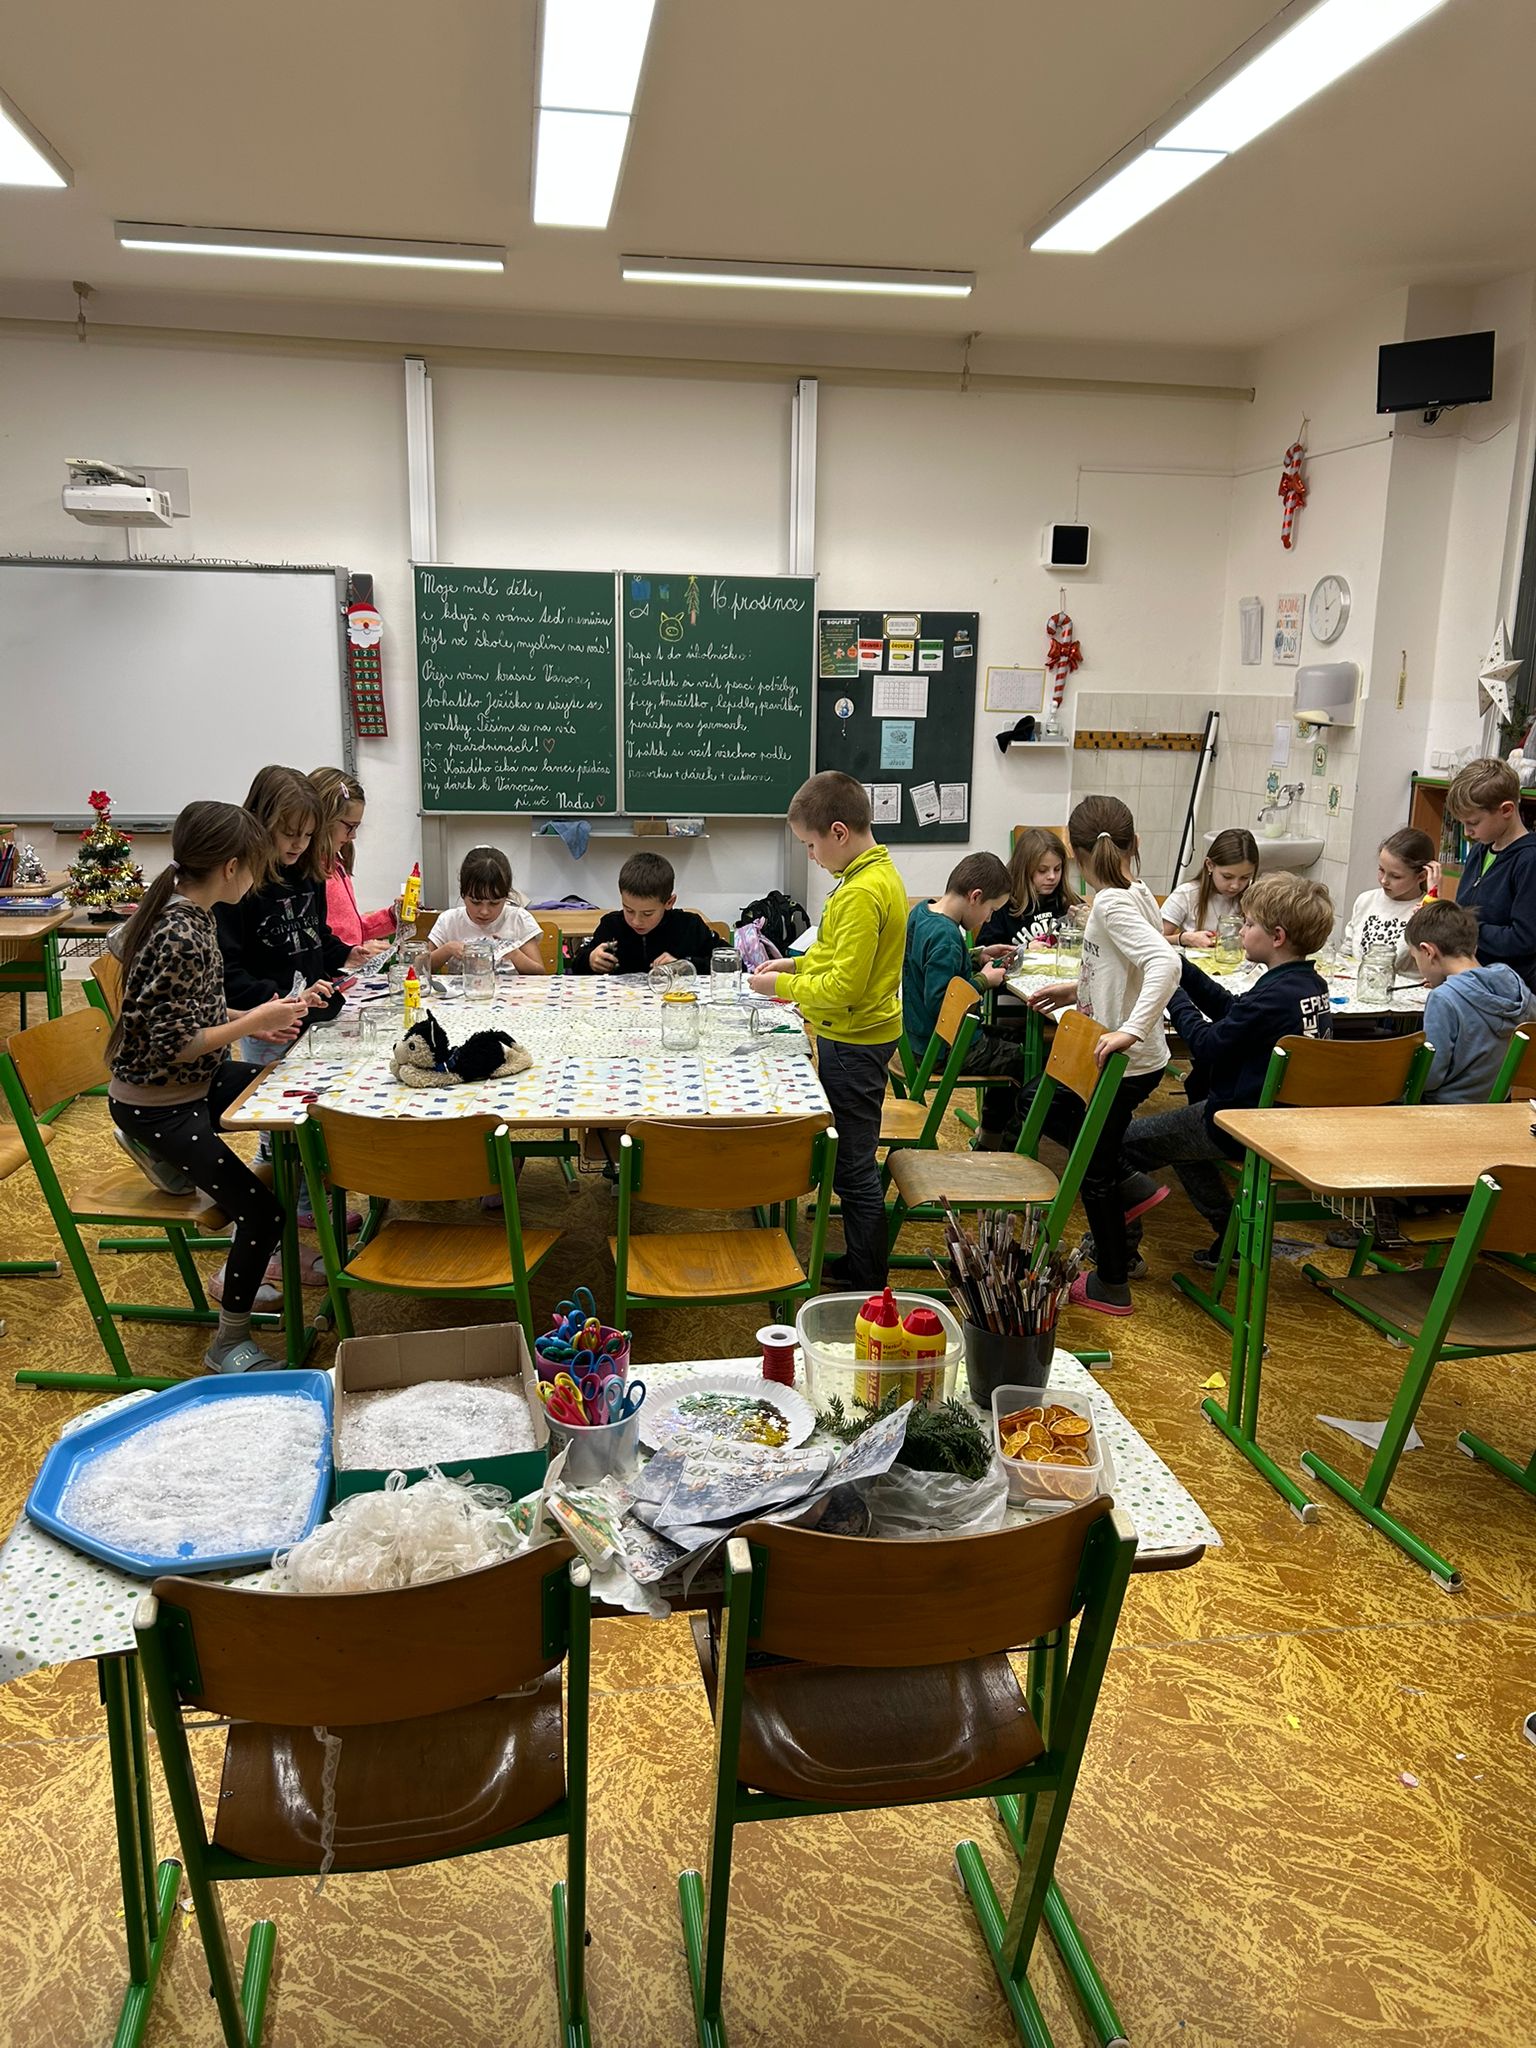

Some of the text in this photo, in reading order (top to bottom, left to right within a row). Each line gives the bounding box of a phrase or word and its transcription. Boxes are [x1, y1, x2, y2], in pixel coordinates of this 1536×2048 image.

[421, 572, 542, 603] Moje milé děti,
[421, 603, 434, 621] i
[441, 602, 477, 632] když
[482, 612, 490, 621] s
[495, 606, 534, 622] vámi
[539, 605, 566, 624] teď
[731, 592, 806, 620] prosince
[421, 627, 610, 659] být ve škole, myslím na vás!
[667, 646, 682, 660] do
[422, 658, 453, 689] Přeji
[456, 664, 490, 681] vám
[494, 661, 536, 682] krásné
[641, 670, 679, 687] čtvrtek
[696, 672, 722, 690] vzít
[725, 676, 756, 695] psací
[758, 676, 799, 699] potřeby,
[422, 687, 483, 708] bohatého
[484, 688, 532, 716] Ježíška
[534, 701, 545, 711] a
[586, 700, 603, 711] se
[627, 690, 657, 717] fixy,
[716, 693, 758, 716] lepidlo,
[758, 696, 802, 718] pravítko,
[424, 712, 577, 740] svátky. Těším se na vás
[628, 713, 750, 738] penízky na jarmark.
[424, 735, 539, 757] po prázdninách!
[625, 739, 792, 761] V pátek si vzít všechno podle
[443, 756, 493, 775] Každého
[494, 755, 520, 773] čeká
[521, 764, 539, 773] na
[541, 757, 576, 774] lavici
[680, 766, 717, 781] dárek
[424, 775, 551, 801] ný dárek k Vánocům.
[555, 791, 595, 810] Naďa
[1034, 912, 1053, 921] MERRY
